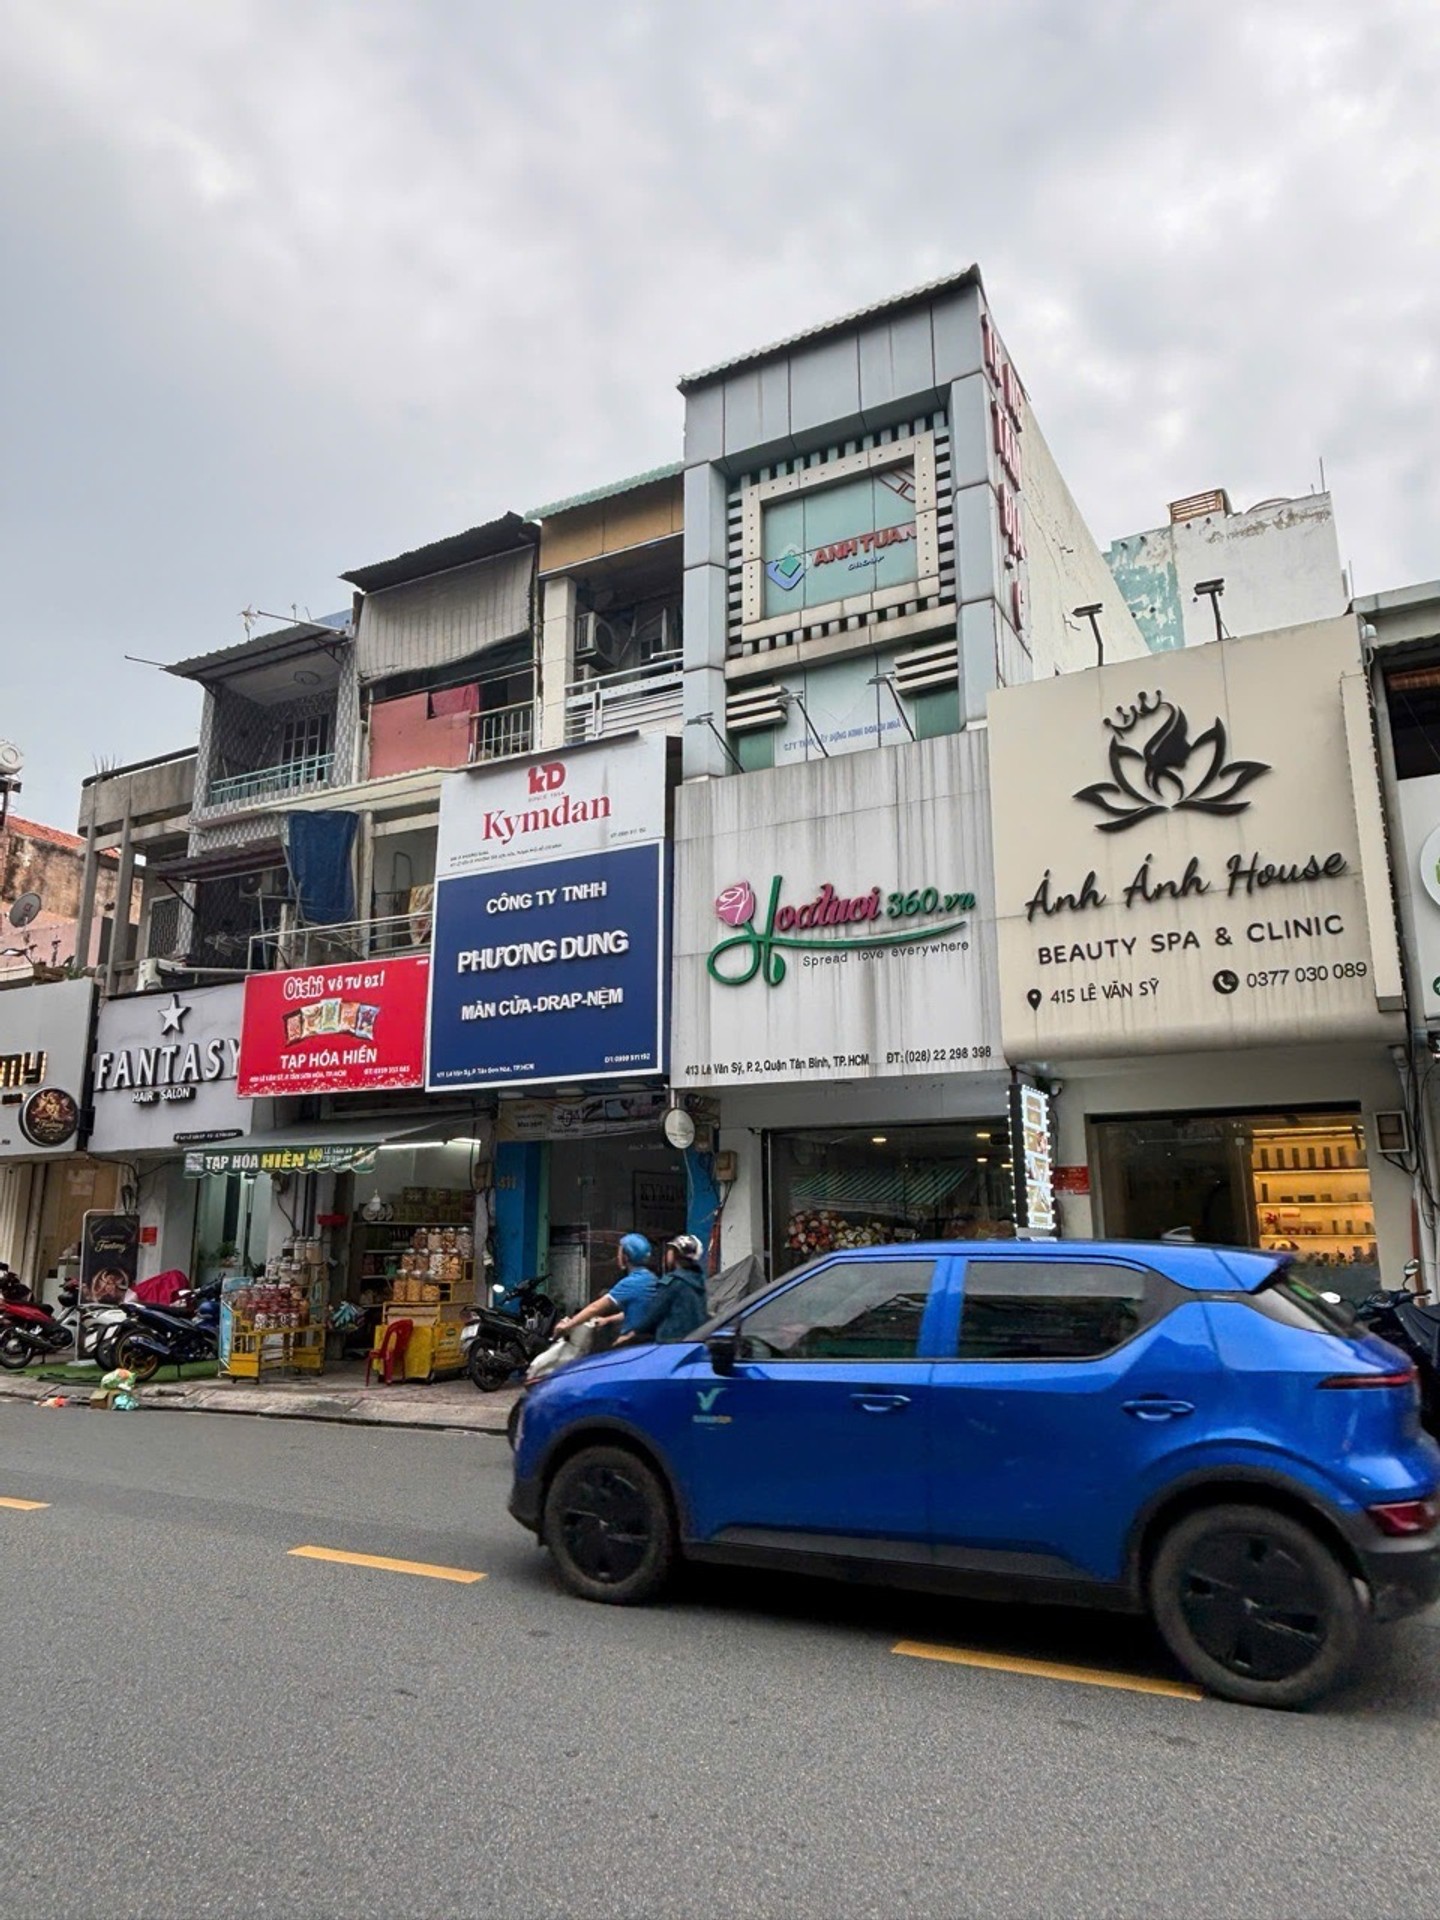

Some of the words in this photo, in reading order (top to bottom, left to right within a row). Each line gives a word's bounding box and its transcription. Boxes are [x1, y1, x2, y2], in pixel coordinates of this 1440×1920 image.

[814, 540, 858, 567] ANH
[482, 795, 612, 845] Kymdan
[1226, 851, 1347, 897] House
[486, 893, 533, 915] CÔNG
[536, 888, 557, 906] TY
[562, 881, 607, 902] TNHH
[887, 885, 977, 919] 360.vn
[457, 939, 558, 973] PHƯƠNG
[560, 930, 629, 960] DUNG
[1039, 936, 1137, 965] BEAUTY
[1151, 930, 1200, 953] SPA
[1215, 927, 1233, 946] &
[1246, 915, 1344, 944] CLINIC
[803, 953, 848, 968] Spread
[857, 949, 884, 962] love
[892, 940, 969, 957] everywhere
[284, 975, 324, 1000] Oishi
[327, 975, 343, 992] VÔ
[1246, 969, 1290, 988] 0377
[1295, 965, 1328, 983] 030
[1333, 961, 1367, 980] 089
[1050, 988, 1075, 1003] 415
[1080, 982, 1097, 1002] LÊ
[1102, 980, 1133, 1000] VĂN
[1139, 977, 1160, 996] SỸ
[461, 1000, 496, 1021] MÀN
[96, 1038, 241, 1090] FANTASY
[280, 1053, 306, 1073] TẠP
[309, 1049, 340, 1067] HÓA
[685, 1065, 699, 1076] 413
[701, 1063, 712, 1075] Lê
[714, 1062, 729, 1074] Văn
[764, 1058, 787, 1072] Quận
[789, 1057, 807, 1069] Tân
[933, 1049, 946, 1061] 22
[950, 1047, 969, 1060] 298
[972, 1045, 992, 1058] 398
[132, 1090, 156, 1103] HAIR
[160, 1087, 192, 1101] SALON
[205, 1155, 229, 1173] TẠP
[232, 1153, 259, 1169] HÓA
